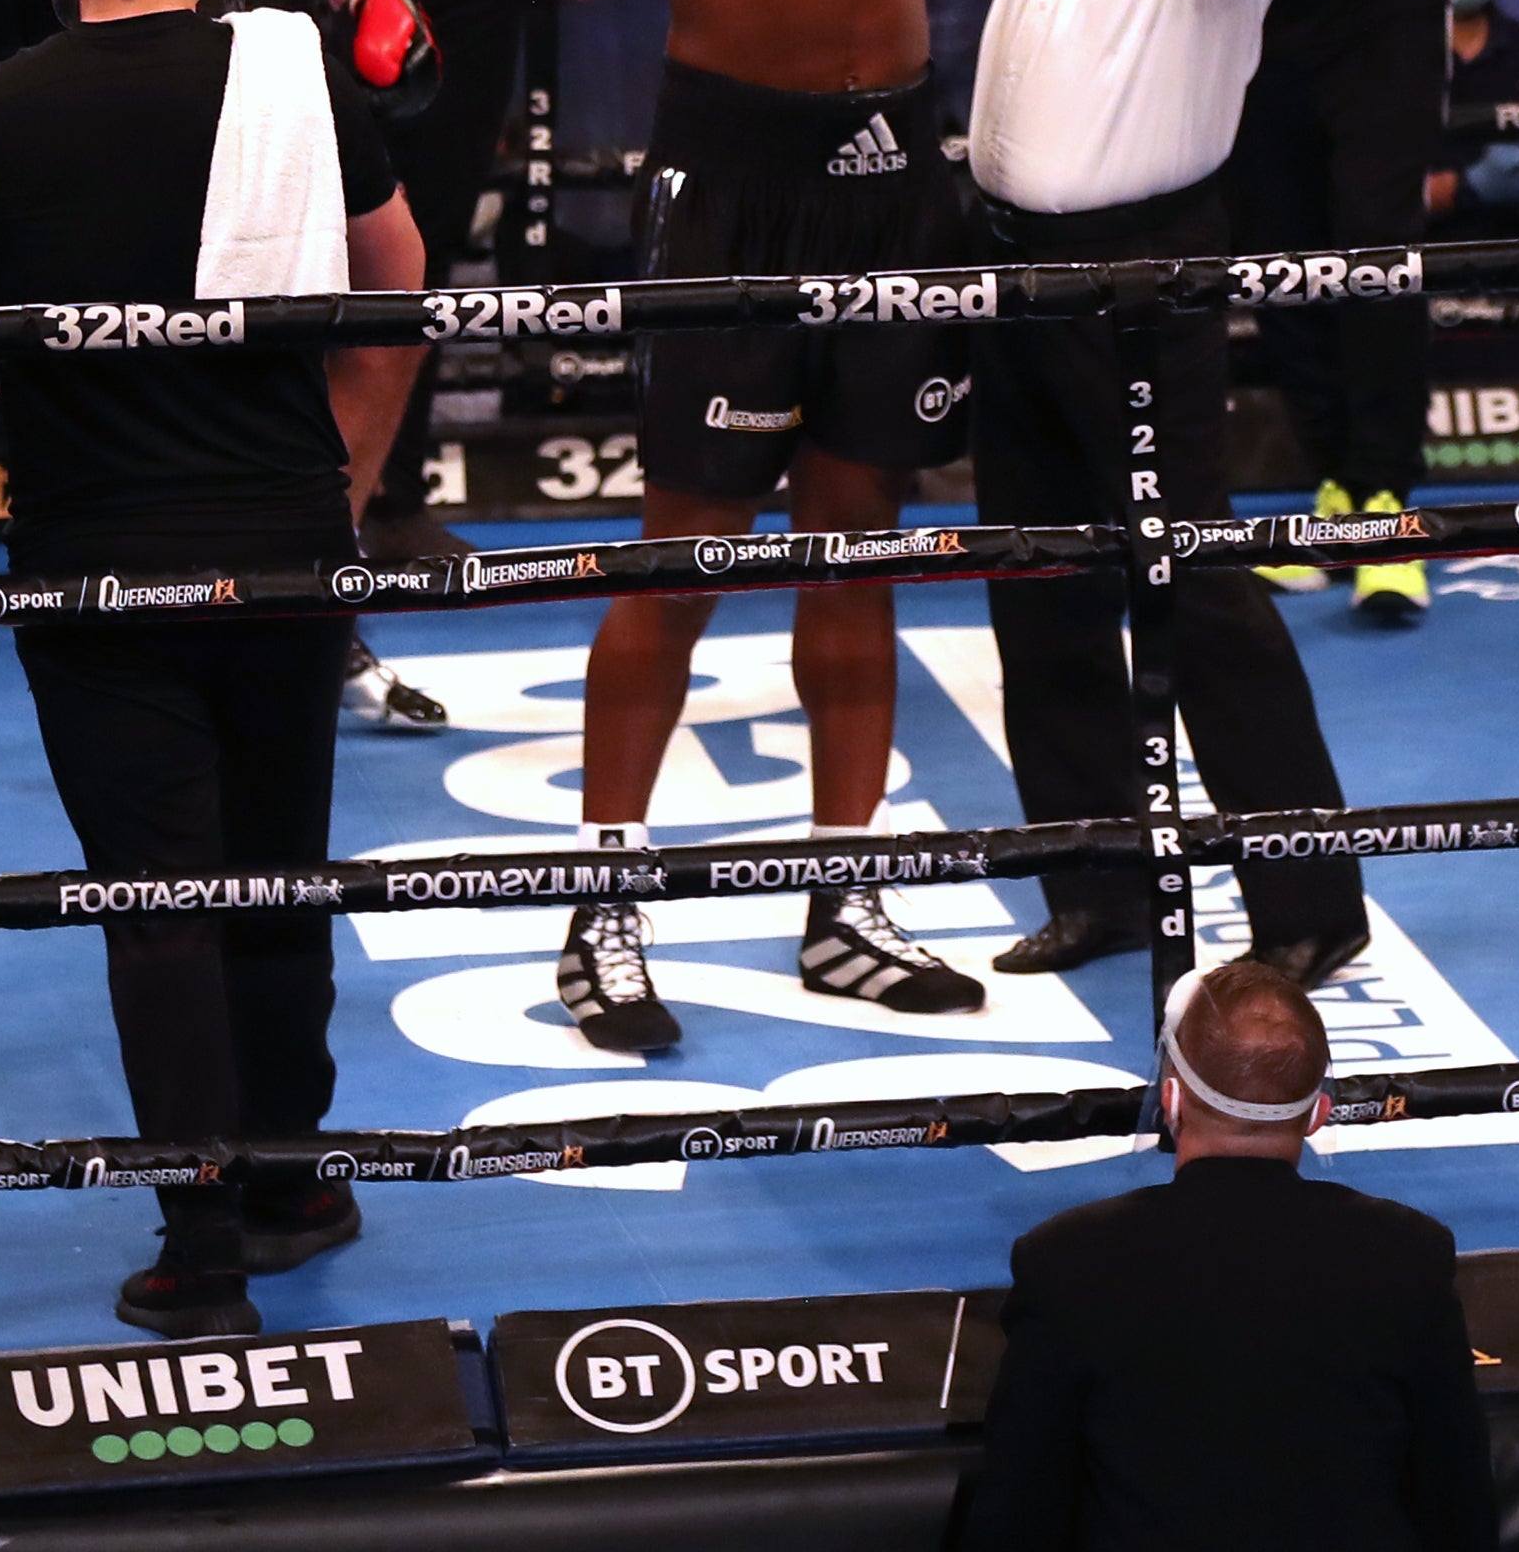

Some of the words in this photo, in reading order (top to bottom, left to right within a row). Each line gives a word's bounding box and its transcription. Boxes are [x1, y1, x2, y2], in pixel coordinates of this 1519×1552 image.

[827, 150, 908, 176] adidas
[797, 273, 997, 323] 32Red
[1227, 251, 1423, 306] 32Red
[43, 301, 245, 349] 32Red
[421, 288, 622, 339] 32Red
[1126, 381, 1174, 587] 32Red
[736, 542, 792, 562] SPORT
[824, 531, 939, 566] QUEENSBERRY
[1201, 526, 1255, 546] SPORT
[1288, 512, 1399, 548] QUEENSBERRY
[9, 590, 65, 611] SPORT
[98, 574, 215, 612] QUEENSBERRY
[375, 572, 431, 591] SPORT
[462, 554, 577, 595] QUEENSBERRY
[1143, 736, 1186, 938] 32Red
[1241, 824, 1463, 862] FOOTASYLUM
[386, 864, 612, 904] FOOTASYLUM
[709, 850, 933, 890] FOOTASYLUM
[60, 876, 285, 915] FOOTASYLUM
[723, 1135, 779, 1153] SPORT
[811, 1117, 928, 1151] QUEENSBERRY
[83, 1156, 199, 1188] QUEENSBERRY
[361, 1161, 416, 1179] SPORT
[447, 1145, 563, 1181] QUEENSBERRY
[10, 1340, 363, 1428] UNIBET
[586, 1354, 662, 1400] BT
[704, 1342, 889, 1396] SPORT
